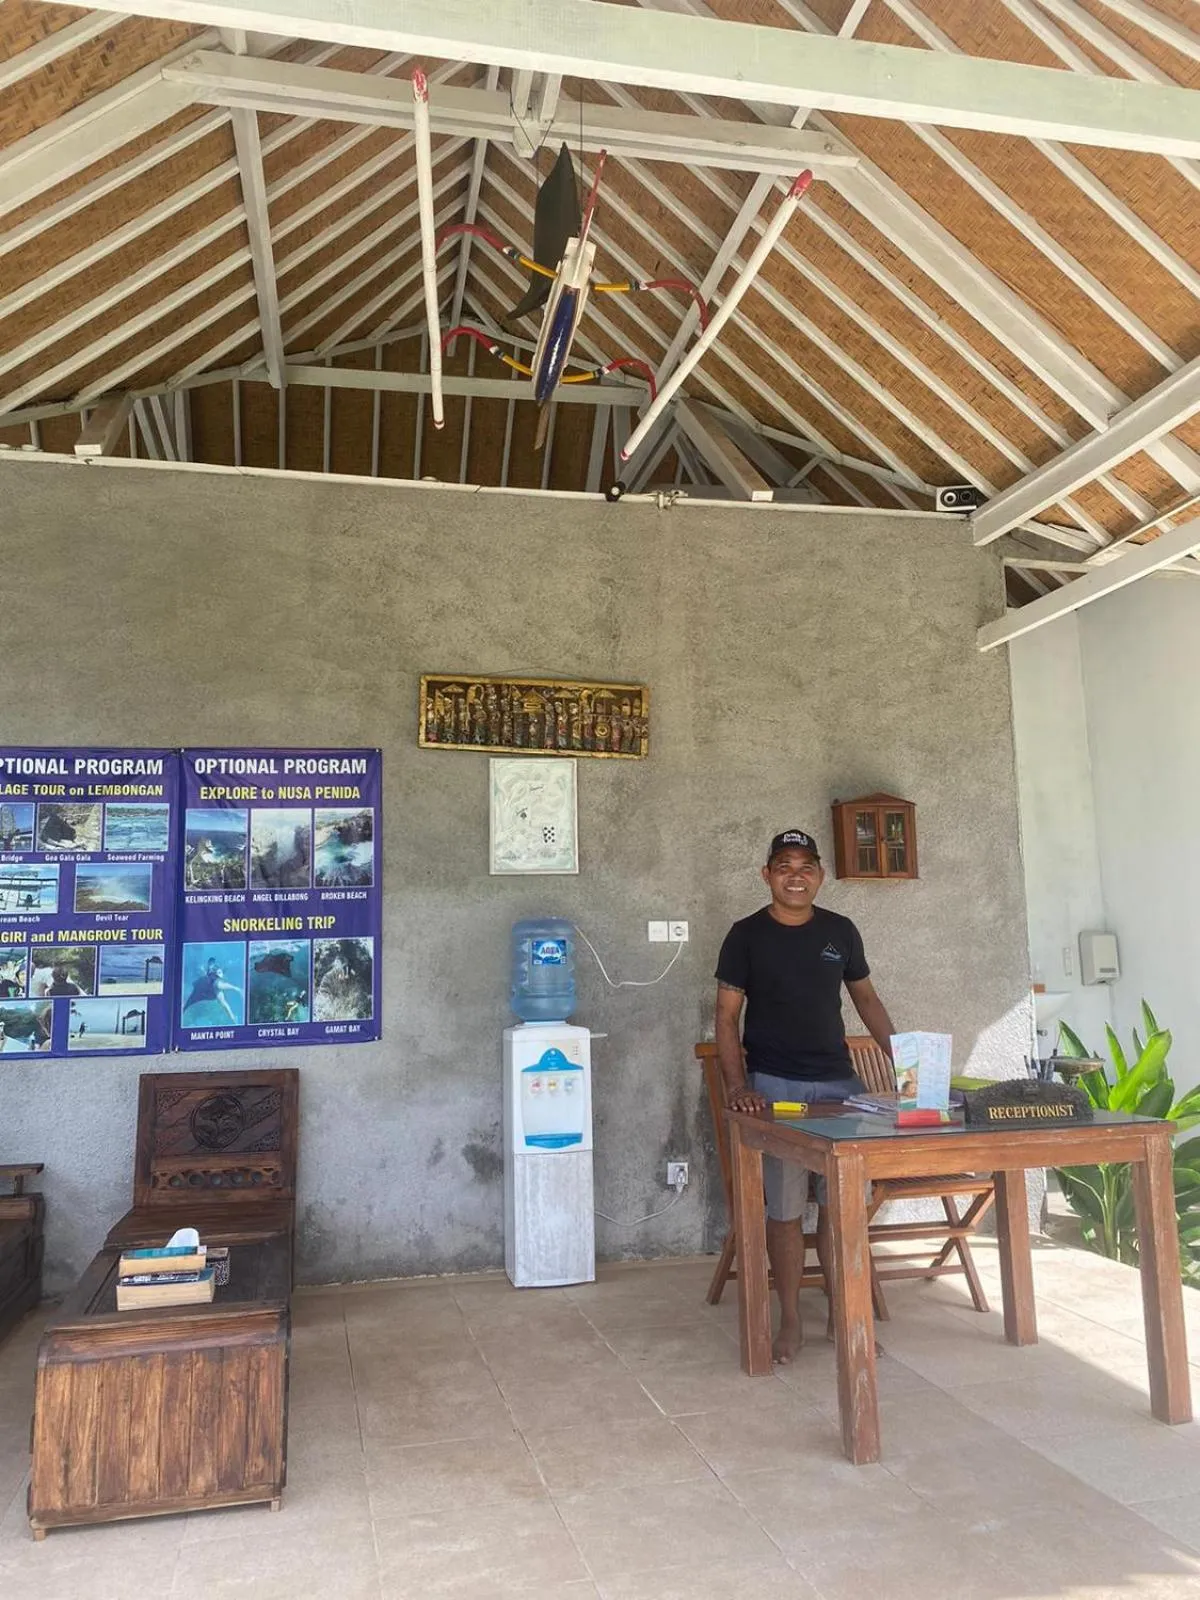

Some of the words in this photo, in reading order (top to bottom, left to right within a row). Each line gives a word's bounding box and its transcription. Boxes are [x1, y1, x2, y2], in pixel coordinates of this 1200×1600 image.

[75, 759, 163, 775] PROGRAM
[194, 758, 278, 774] OPTIONAL
[284, 758, 366, 774] PROGRAM
[34, 784, 66, 796] TOUR
[69, 786, 84, 796] on
[88, 785, 163, 796] LEMBONGAN
[200, 786, 257, 800] EXPLORE
[261, 787, 275, 800] to
[278, 786, 312, 800] NUSA
[315, 786, 360, 799] PENIDA
[107, 854, 137, 862] Seaweed
[138, 854, 164, 862] Farming
[185, 894, 223, 904] KELINGKING
[224, 894, 246, 903] BEACH
[252, 893, 273, 902] ANGEL
[274, 892, 308, 902] BILLABONG
[321, 892, 345, 900] BROKEN
[346, 891, 367, 900] BEACH
[95, 914, 112, 922] Devil
[223, 917, 303, 932] SNORKELING
[307, 916, 336, 929] TRIP
[0, 931, 26, 943] GIRI
[31, 931, 54, 942] and
[58, 930, 127, 942] MANGROVE
[132, 928, 164, 940] TOUR
[258, 1029, 286, 1038] CRYSTAL
[286, 1028, 300, 1036] BAY
[325, 1026, 347, 1034] GAMAT
[348, 1024, 361, 1033] BAY
[190, 1032, 214, 1040] MANTA
[214, 1030, 234, 1040] POINT
[988, 1104, 1074, 1120] RECEPTIONIST
